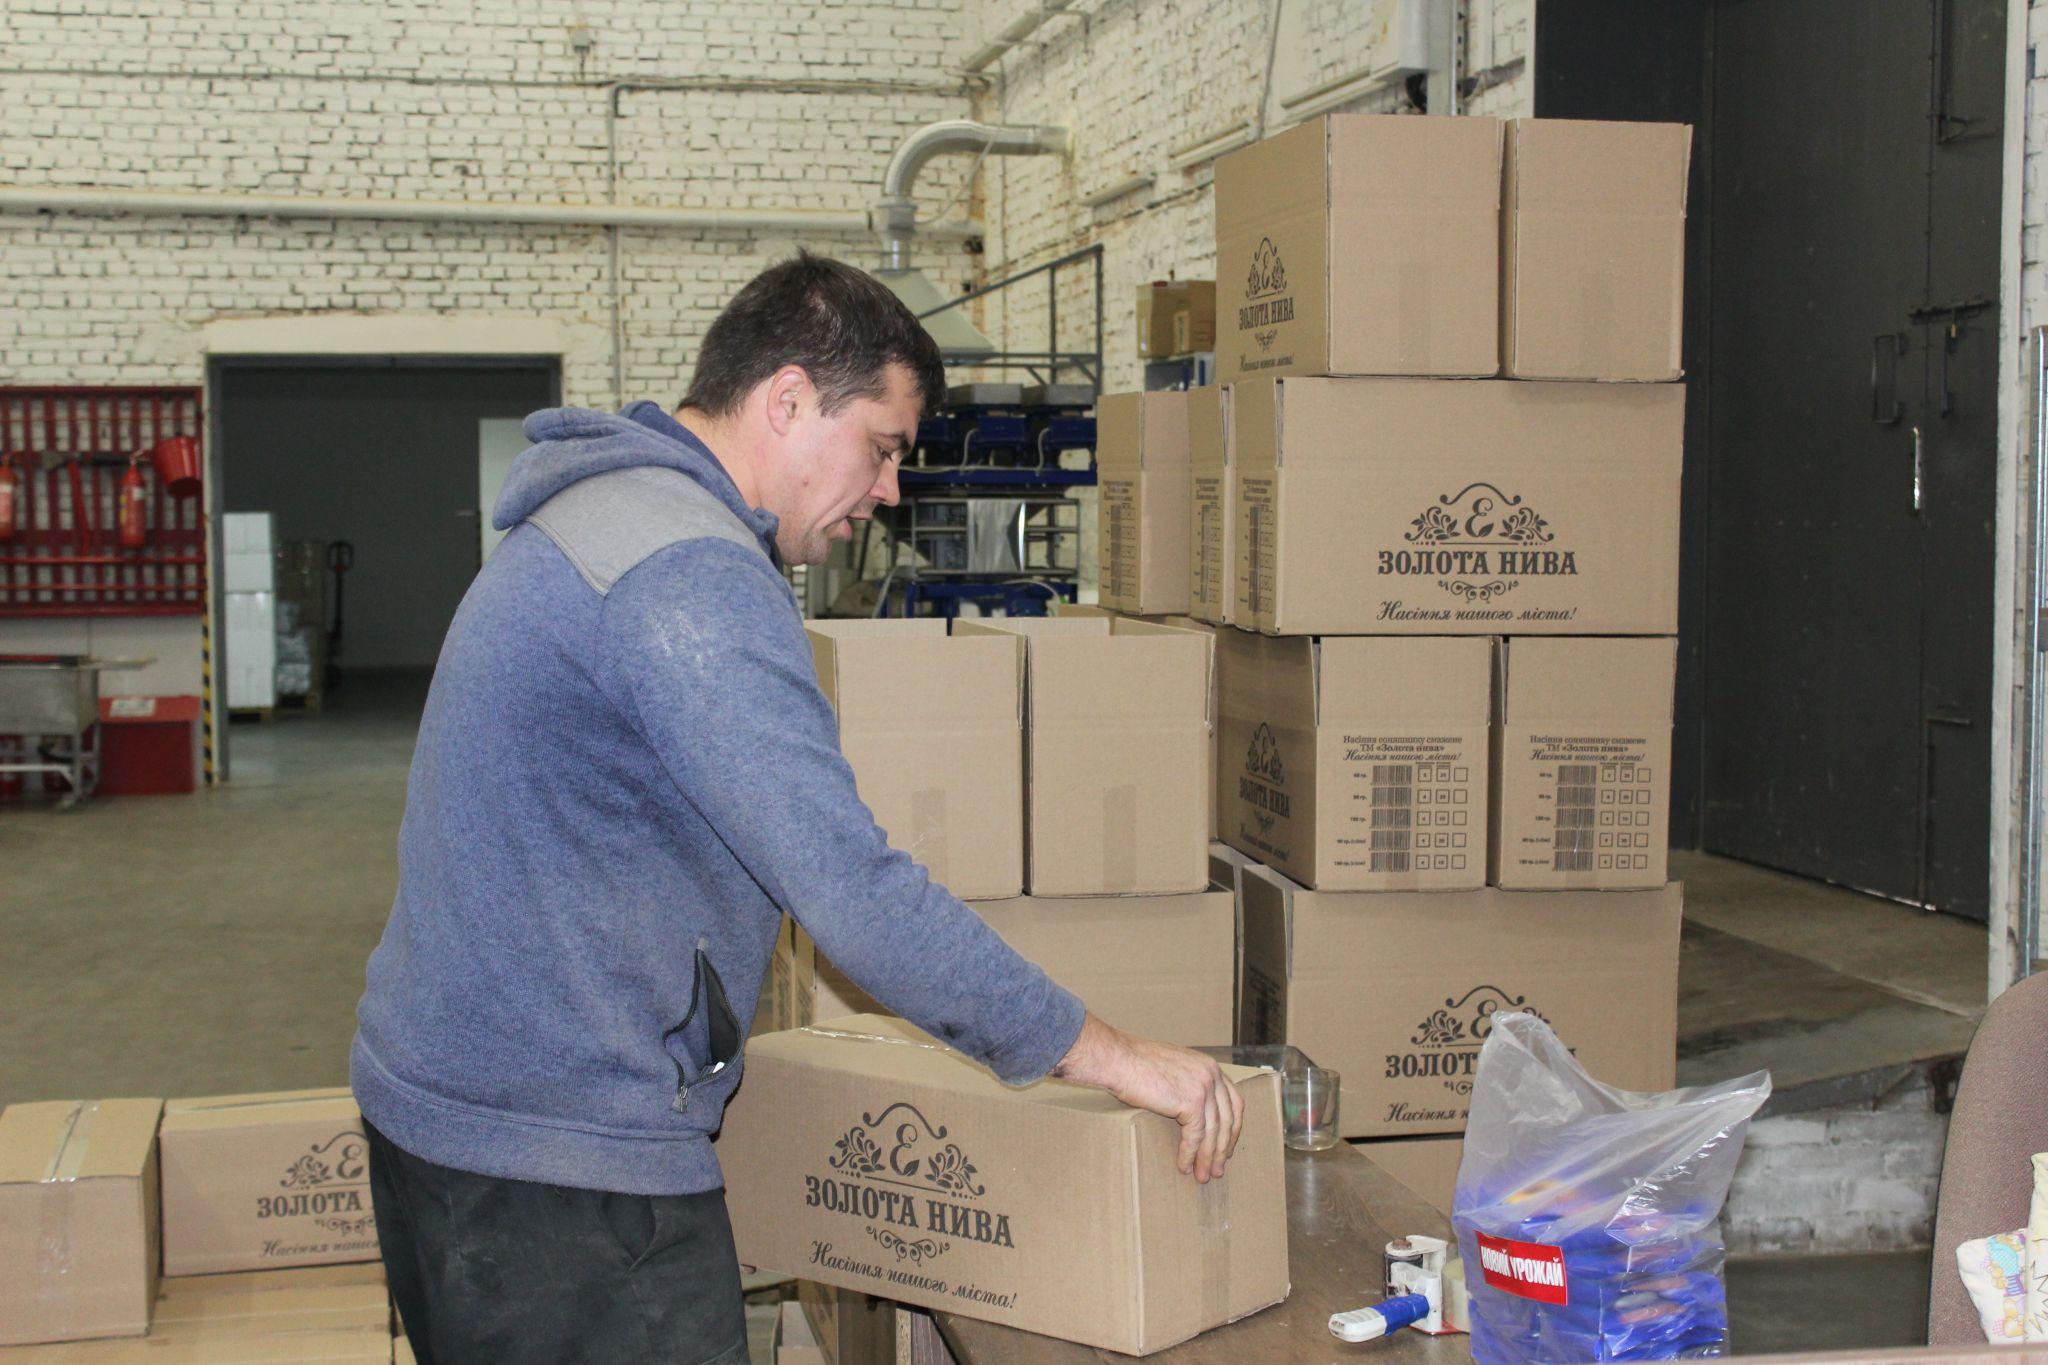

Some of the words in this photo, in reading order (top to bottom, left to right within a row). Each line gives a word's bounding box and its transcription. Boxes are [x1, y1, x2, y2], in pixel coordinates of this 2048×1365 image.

[1239, 303, 1269, 331] ЗОЛОТА
[1271, 297, 1294, 323] НИВА
[1378, 550, 1490, 575] ЗОЛОТА
[1498, 551, 1578, 576] НИВА
[1376, 600, 1451, 621] Насіння
[1455, 608, 1513, 621] нашого
[1517, 606, 1577, 621] міста!
[1385, 1053, 1479, 1078] ЗОЛОТ
[1384, 1103, 1456, 1122] Насіння
[257, 1191, 362, 1218] ЗОЛОТА
[805, 1174, 919, 1228] ЗОЛОТА
[926, 1199, 1015, 1248] НИВА
[260, 1239, 329, 1257] Насіння
[809, 1240, 883, 1279] Насіння
[886, 1269, 949, 1294] нашого
[951, 1285, 1017, 1309] міста!
[1480, 1246, 1511, 1277] НОВИЙ
[1509, 1256, 1564, 1287] УРОЖАЙ
